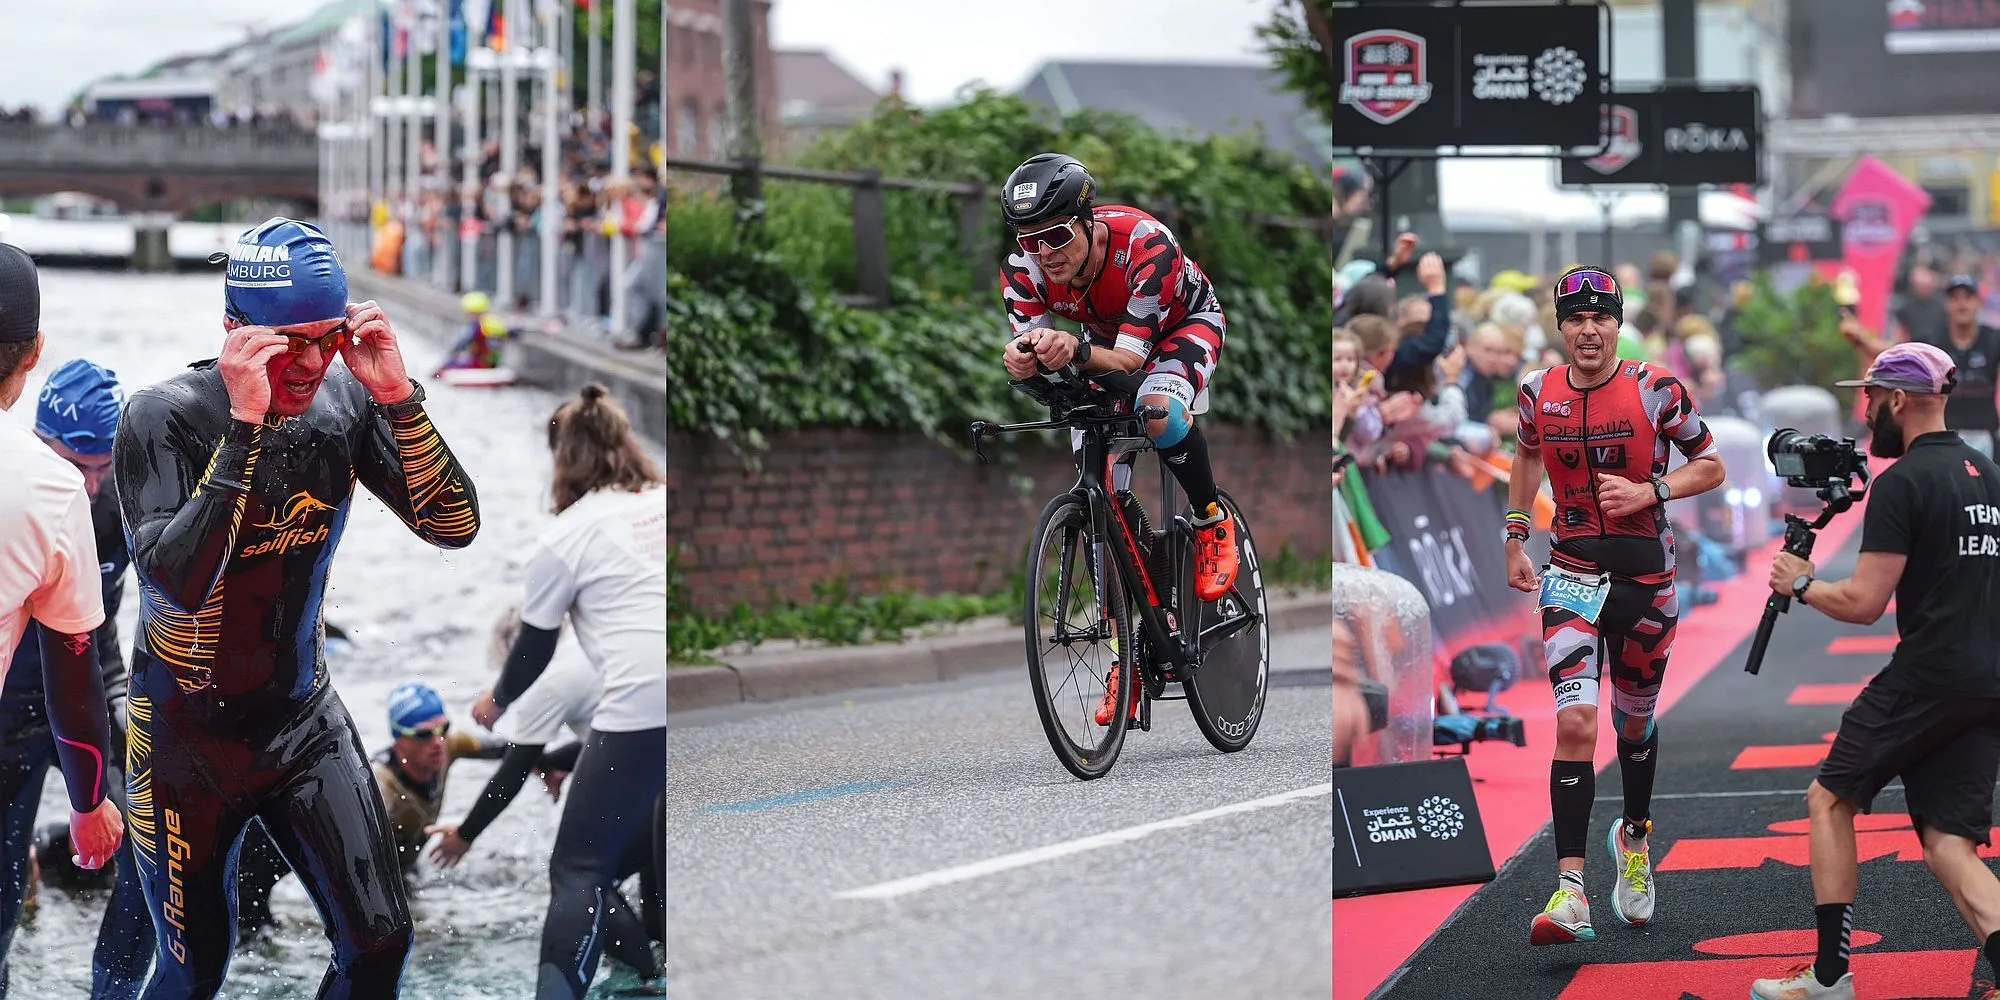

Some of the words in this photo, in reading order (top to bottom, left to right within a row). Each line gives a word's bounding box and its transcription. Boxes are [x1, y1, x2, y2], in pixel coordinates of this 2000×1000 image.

[227, 264, 291, 279] AMBURG
[1543, 419, 1634, 436] OPTIMUM
[240, 524, 329, 558] sailfish
[1546, 577, 1593, 603] 1088
[1550, 590, 1577, 602] Sascha
[1554, 681, 1582, 699] ERGO
[1363, 805, 1410, 818] Experience
[1369, 827, 1418, 843] OMAN
